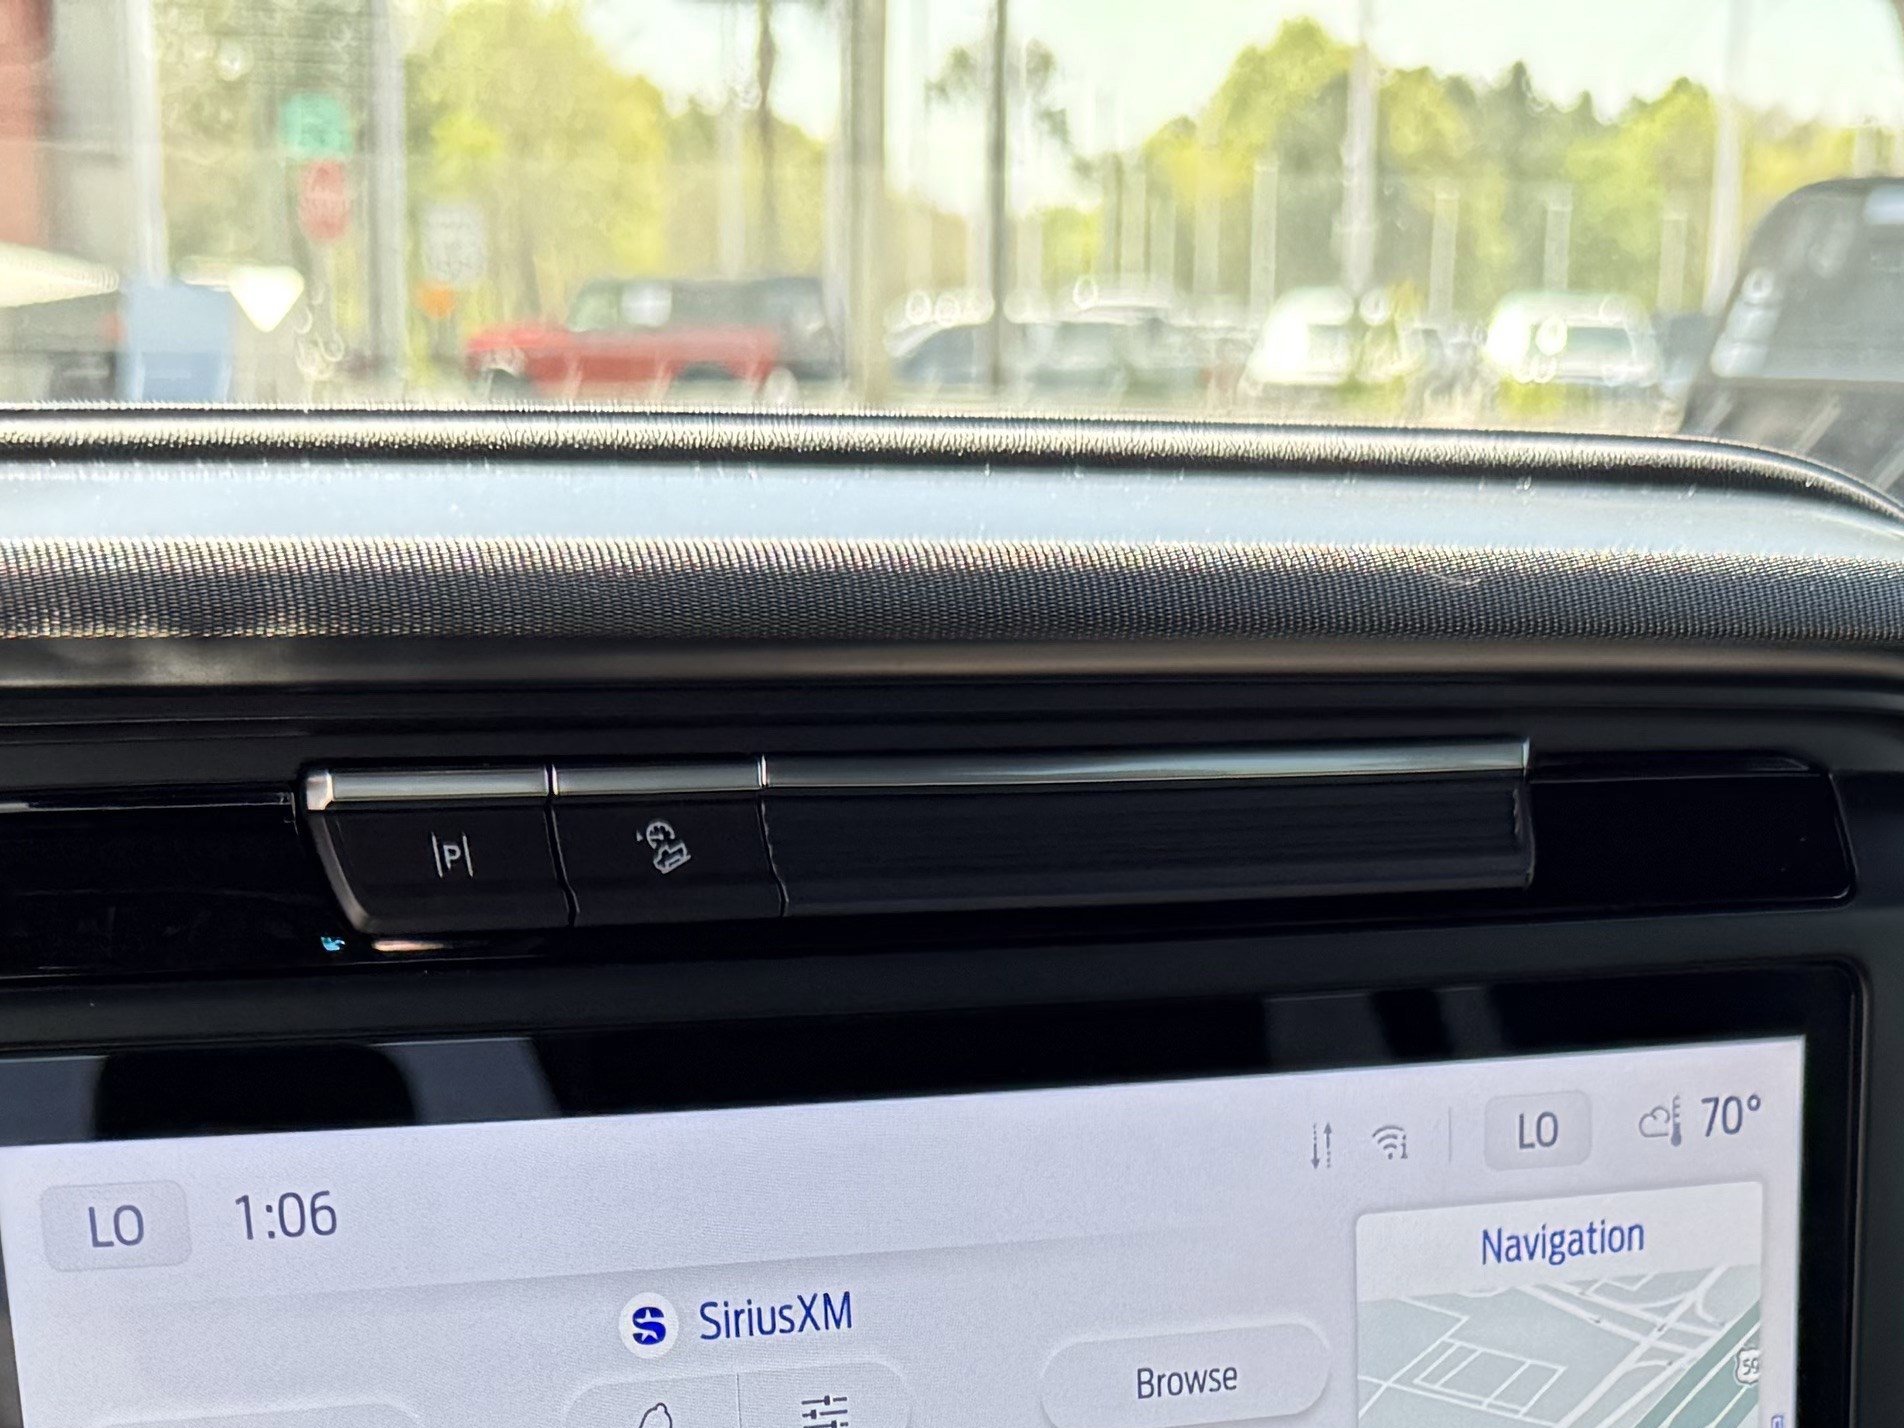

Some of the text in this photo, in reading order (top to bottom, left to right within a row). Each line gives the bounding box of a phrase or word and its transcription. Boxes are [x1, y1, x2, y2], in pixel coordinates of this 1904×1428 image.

[1518, 1111, 1559, 1149] LO
[1701, 1094, 1761, 1138] 70°
[88, 1204, 145, 1248] LO
[235, 1190, 337, 1240] 1:06
[1482, 1219, 1644, 1266] Navigation
[699, 1290, 852, 1340] SiriusXM
[1137, 1366, 1238, 1400] Browse
